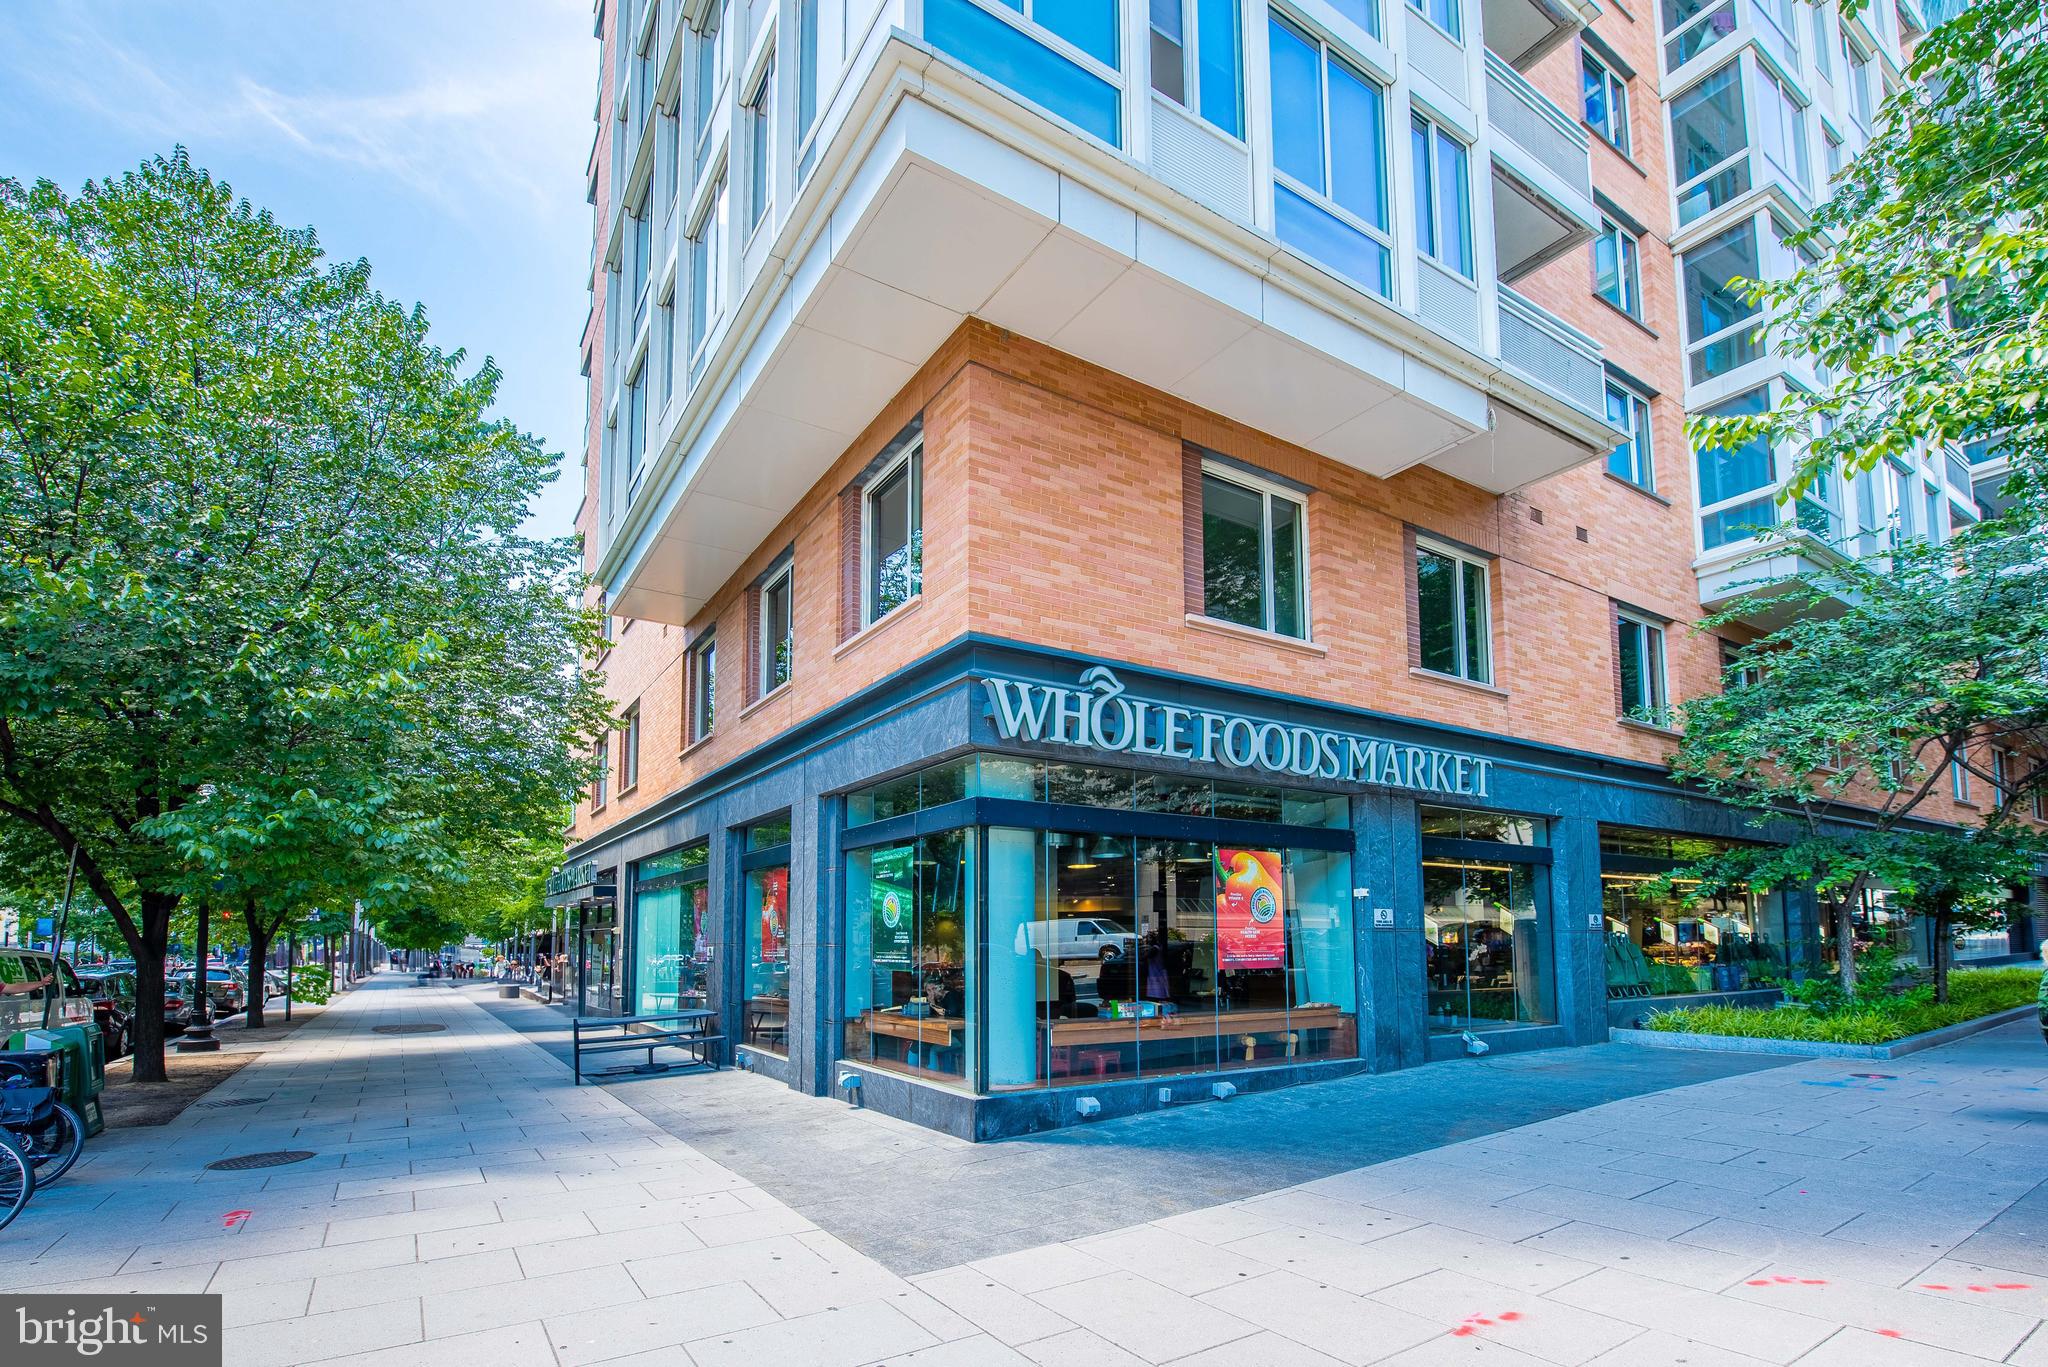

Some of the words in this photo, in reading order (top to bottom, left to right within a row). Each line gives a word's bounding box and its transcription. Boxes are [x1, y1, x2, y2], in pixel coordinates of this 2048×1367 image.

[981, 666, 1193, 760] WHOLE
[1199, 712, 1341, 780] FOODS
[1347, 737, 1494, 797] MARKET
